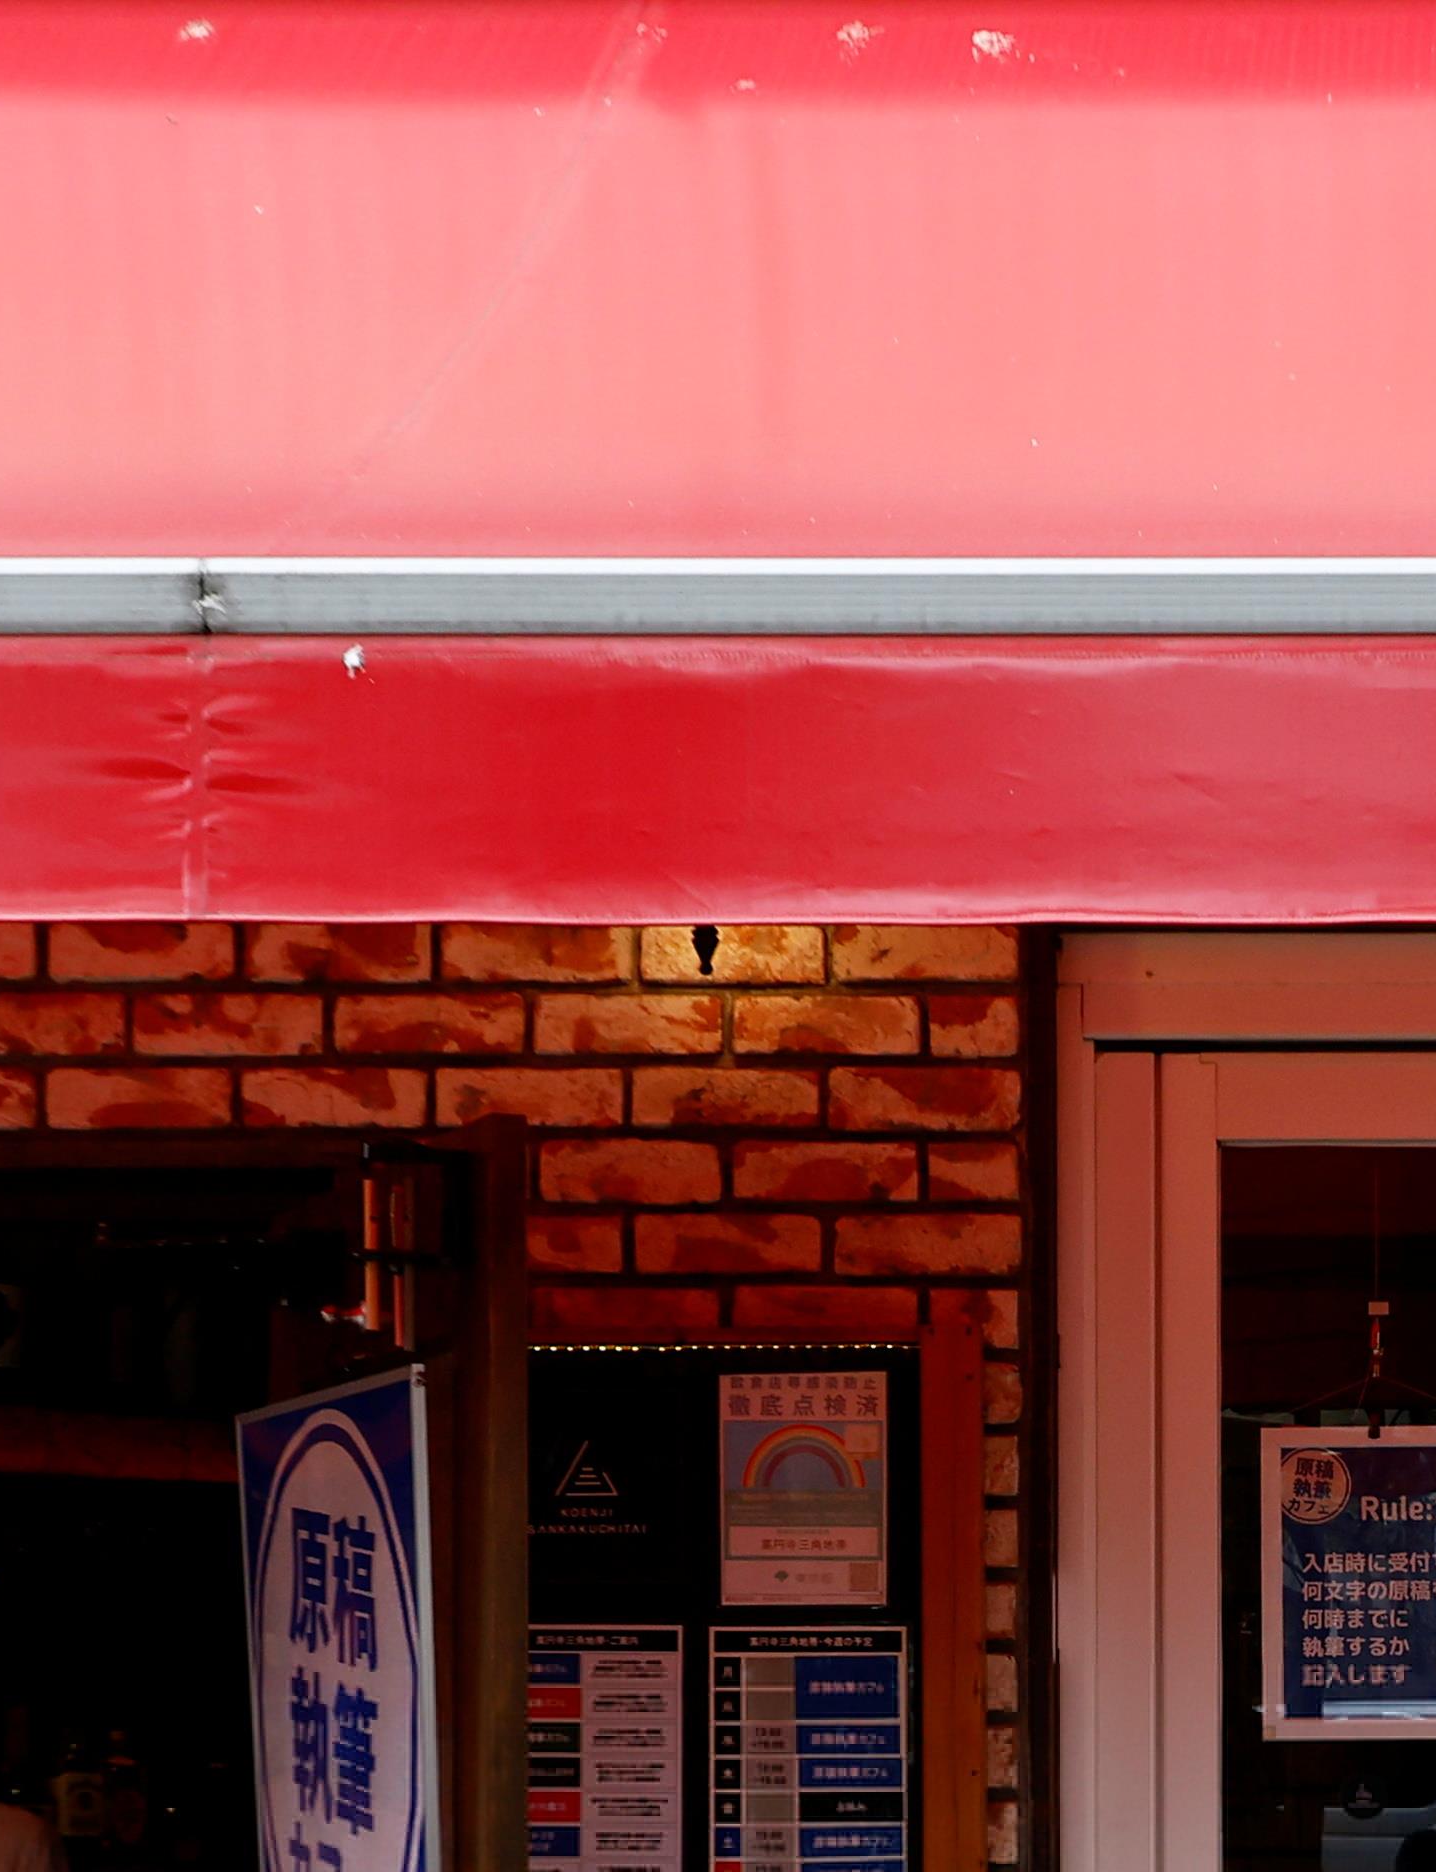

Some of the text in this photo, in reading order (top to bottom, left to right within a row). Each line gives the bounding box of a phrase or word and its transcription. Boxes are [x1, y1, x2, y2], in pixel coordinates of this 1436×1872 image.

[728, 1394, 879, 1416] 徹底点検済
[559, 1507, 613, 1518] KOENJI
[1287, 1498, 1330, 1514] カフェ
[289, 1506, 379, 1673] 原稿
[1302, 1608, 1409, 1629] 何時までに
[1302, 1636, 1410, 1657] 執筆するか
[289, 1665, 379, 1836] 執筆
